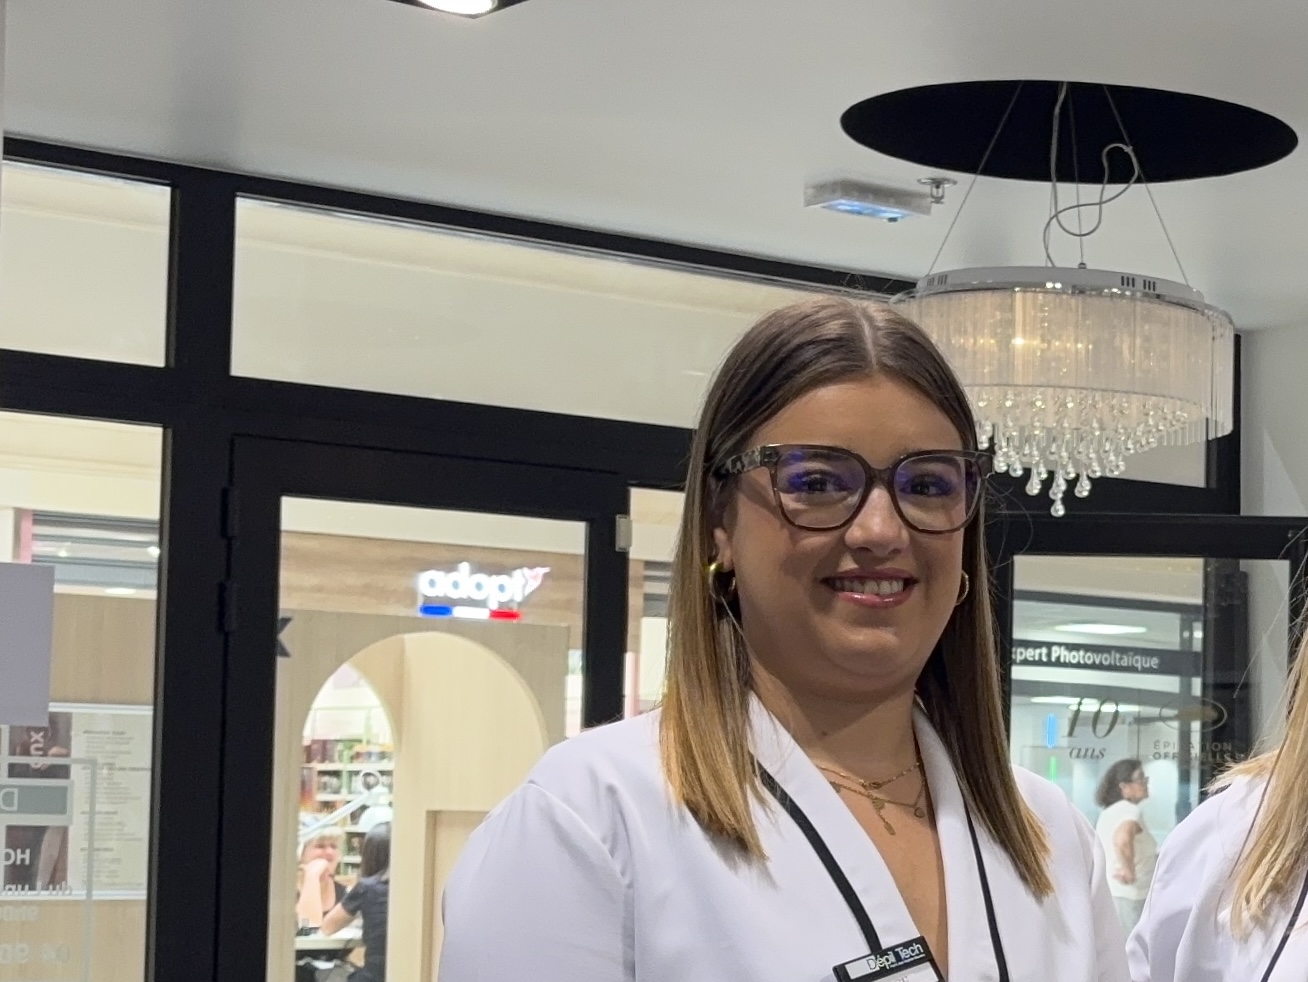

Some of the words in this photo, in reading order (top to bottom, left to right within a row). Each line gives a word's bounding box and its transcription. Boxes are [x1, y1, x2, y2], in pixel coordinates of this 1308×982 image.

[1051, 645, 1160, 671] Photovoltaïque
[866, 951, 897, 970] Dépil
[894, 943, 924, 960] Tech
